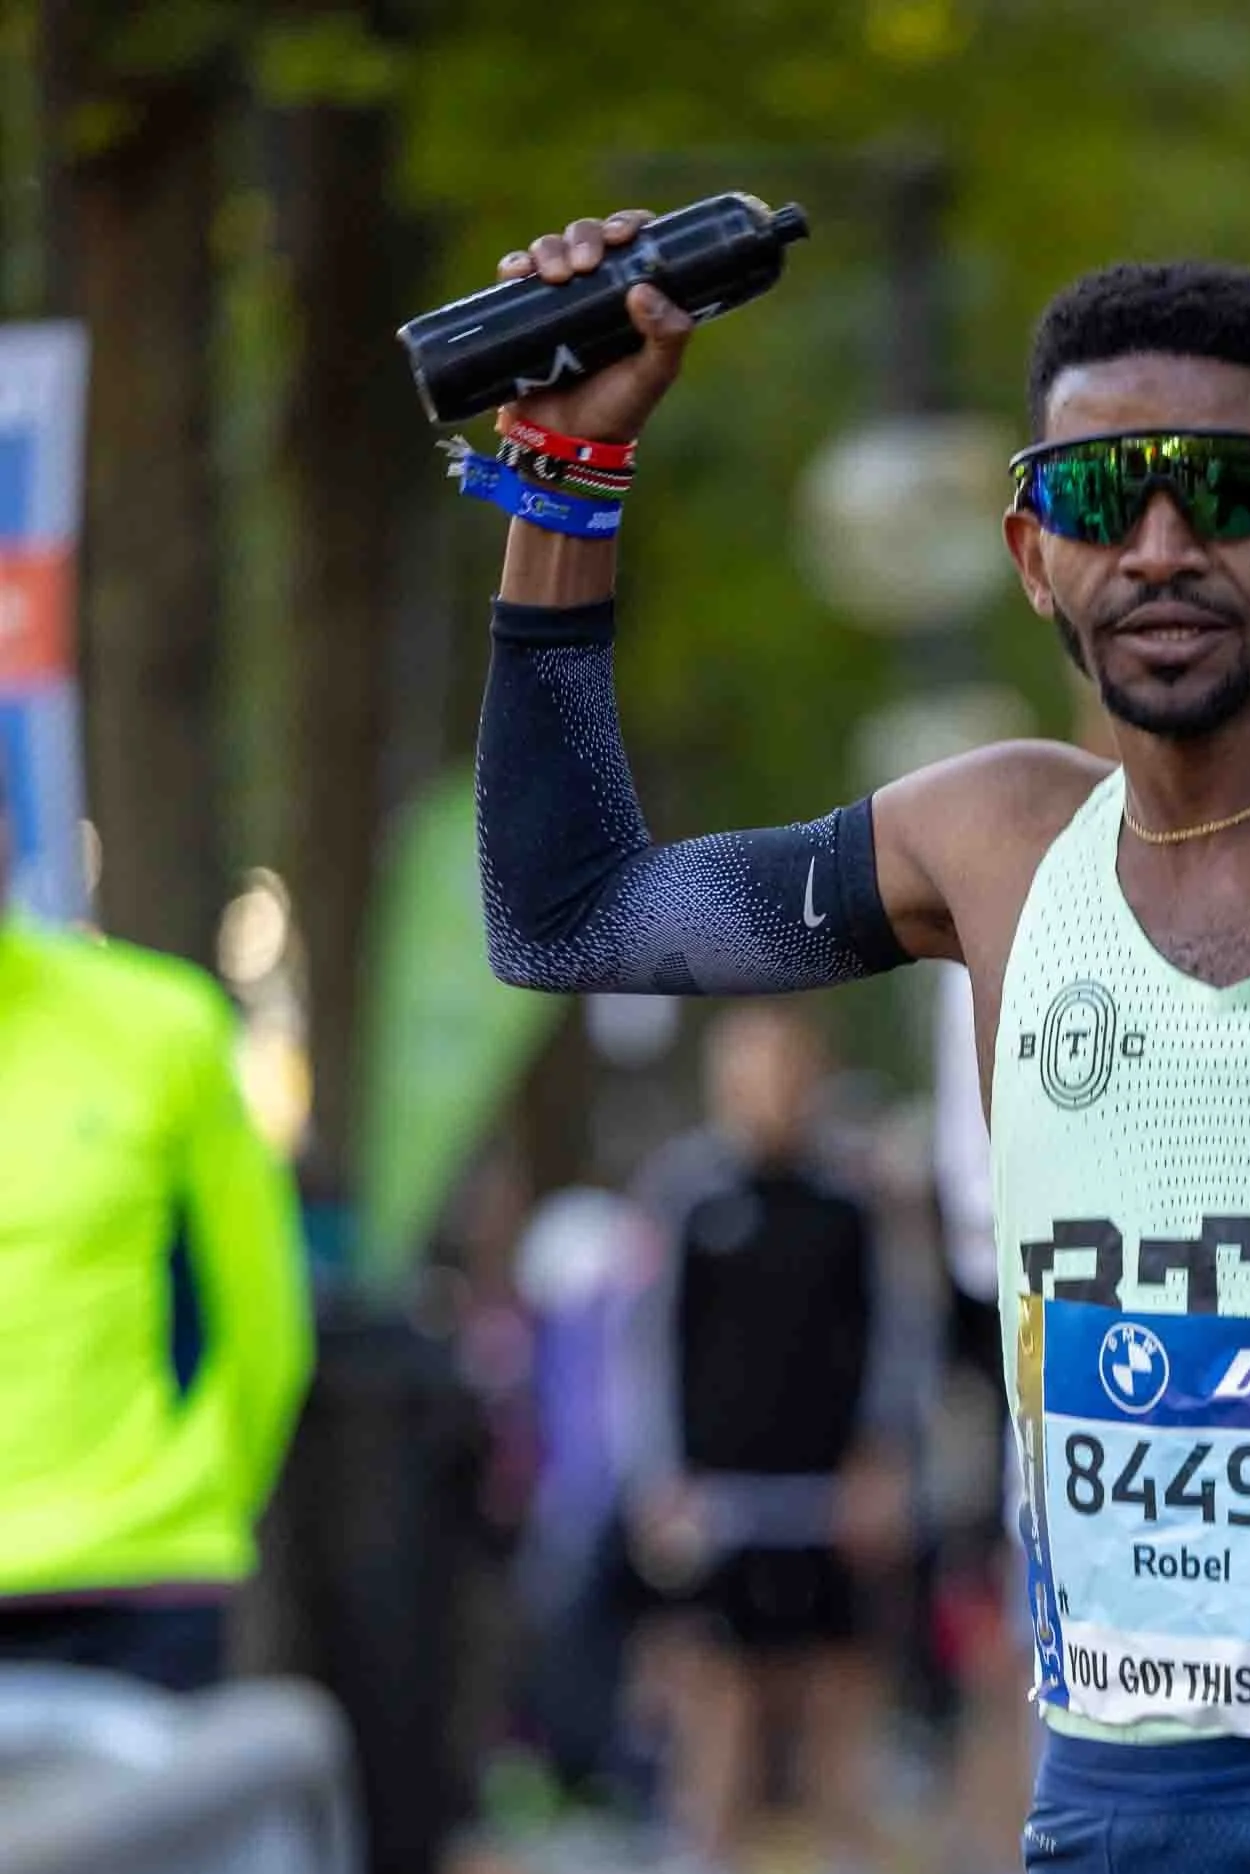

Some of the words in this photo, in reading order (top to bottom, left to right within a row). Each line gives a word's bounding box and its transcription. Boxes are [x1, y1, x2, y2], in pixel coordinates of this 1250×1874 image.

[1133, 1544, 1231, 1583] Robel
[1067, 1642, 1109, 1692] YOU
[1118, 1656, 1176, 1699] GOT
